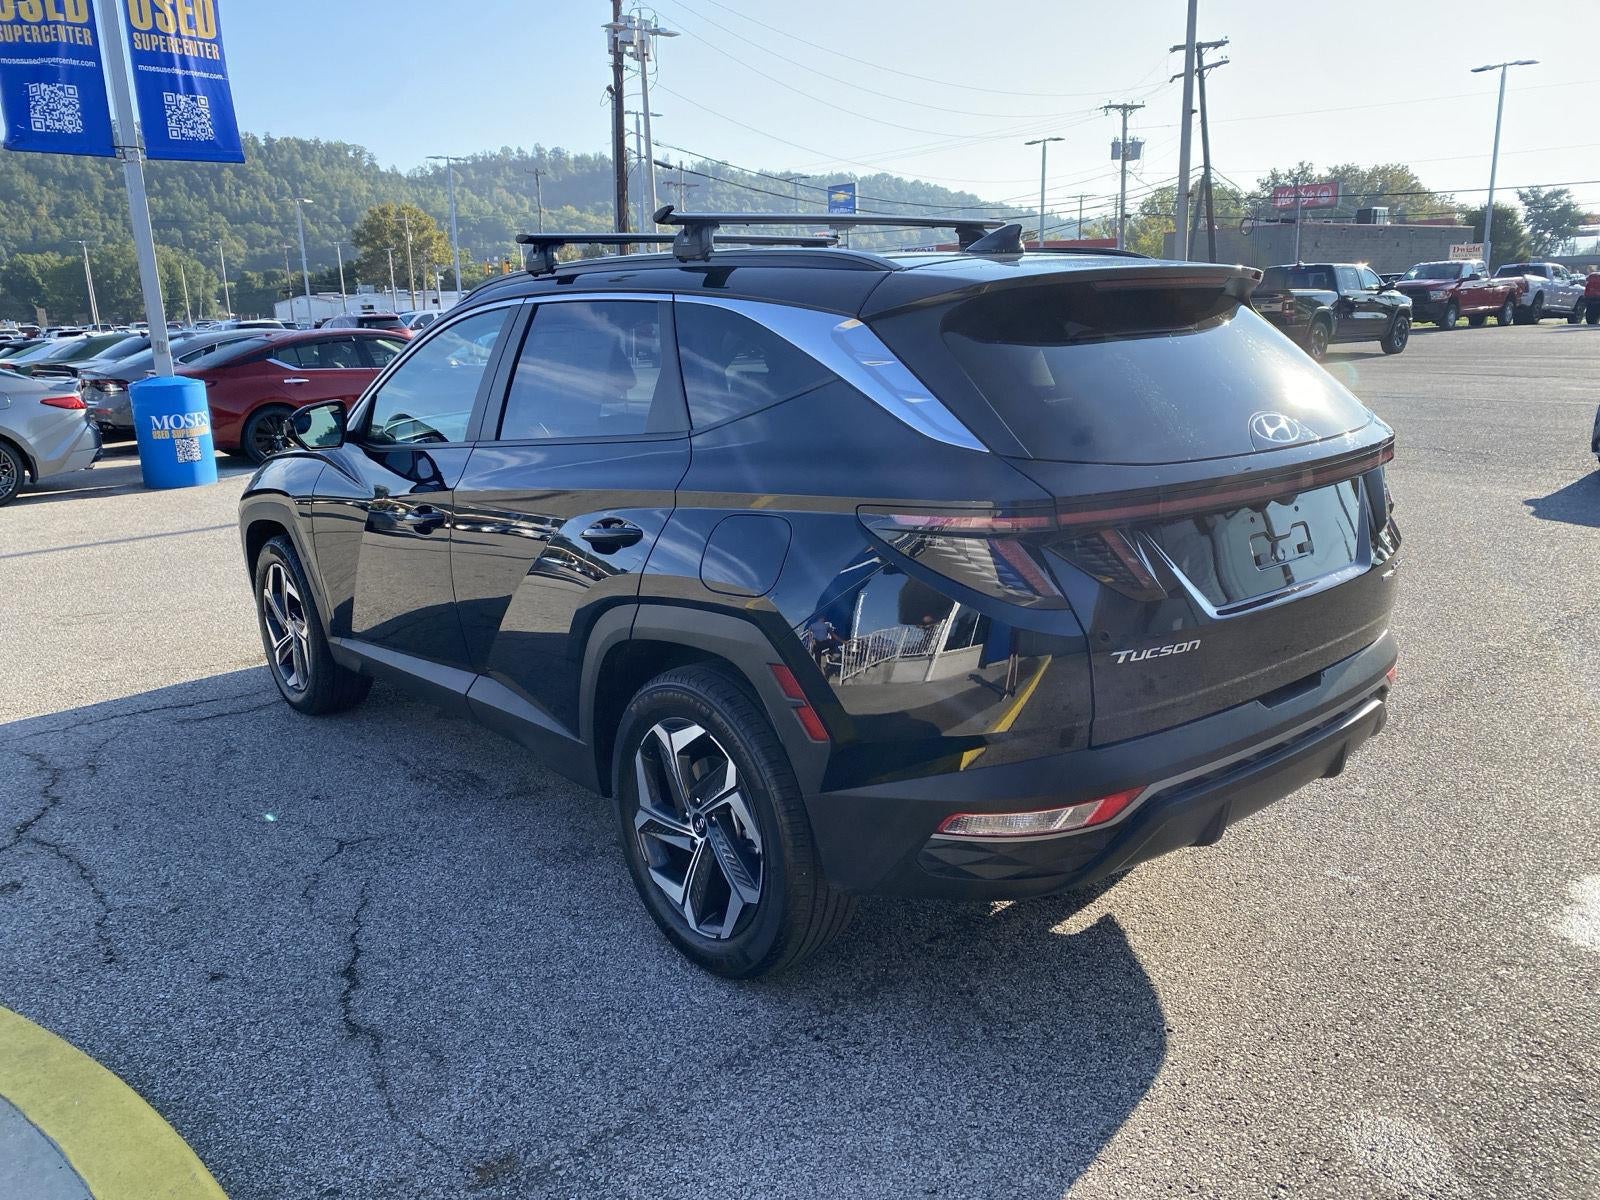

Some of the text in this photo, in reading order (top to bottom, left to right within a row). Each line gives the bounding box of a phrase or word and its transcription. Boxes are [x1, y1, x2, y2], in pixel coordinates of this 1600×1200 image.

[128, 0, 217, 40] USED
[133, 32, 221, 60] SUPERCENTER
[0, 56, 96, 67] mosesusedsupercenter.com
[150, 411, 209, 430] MOSES
[1110, 639, 1201, 664] TUCSON
